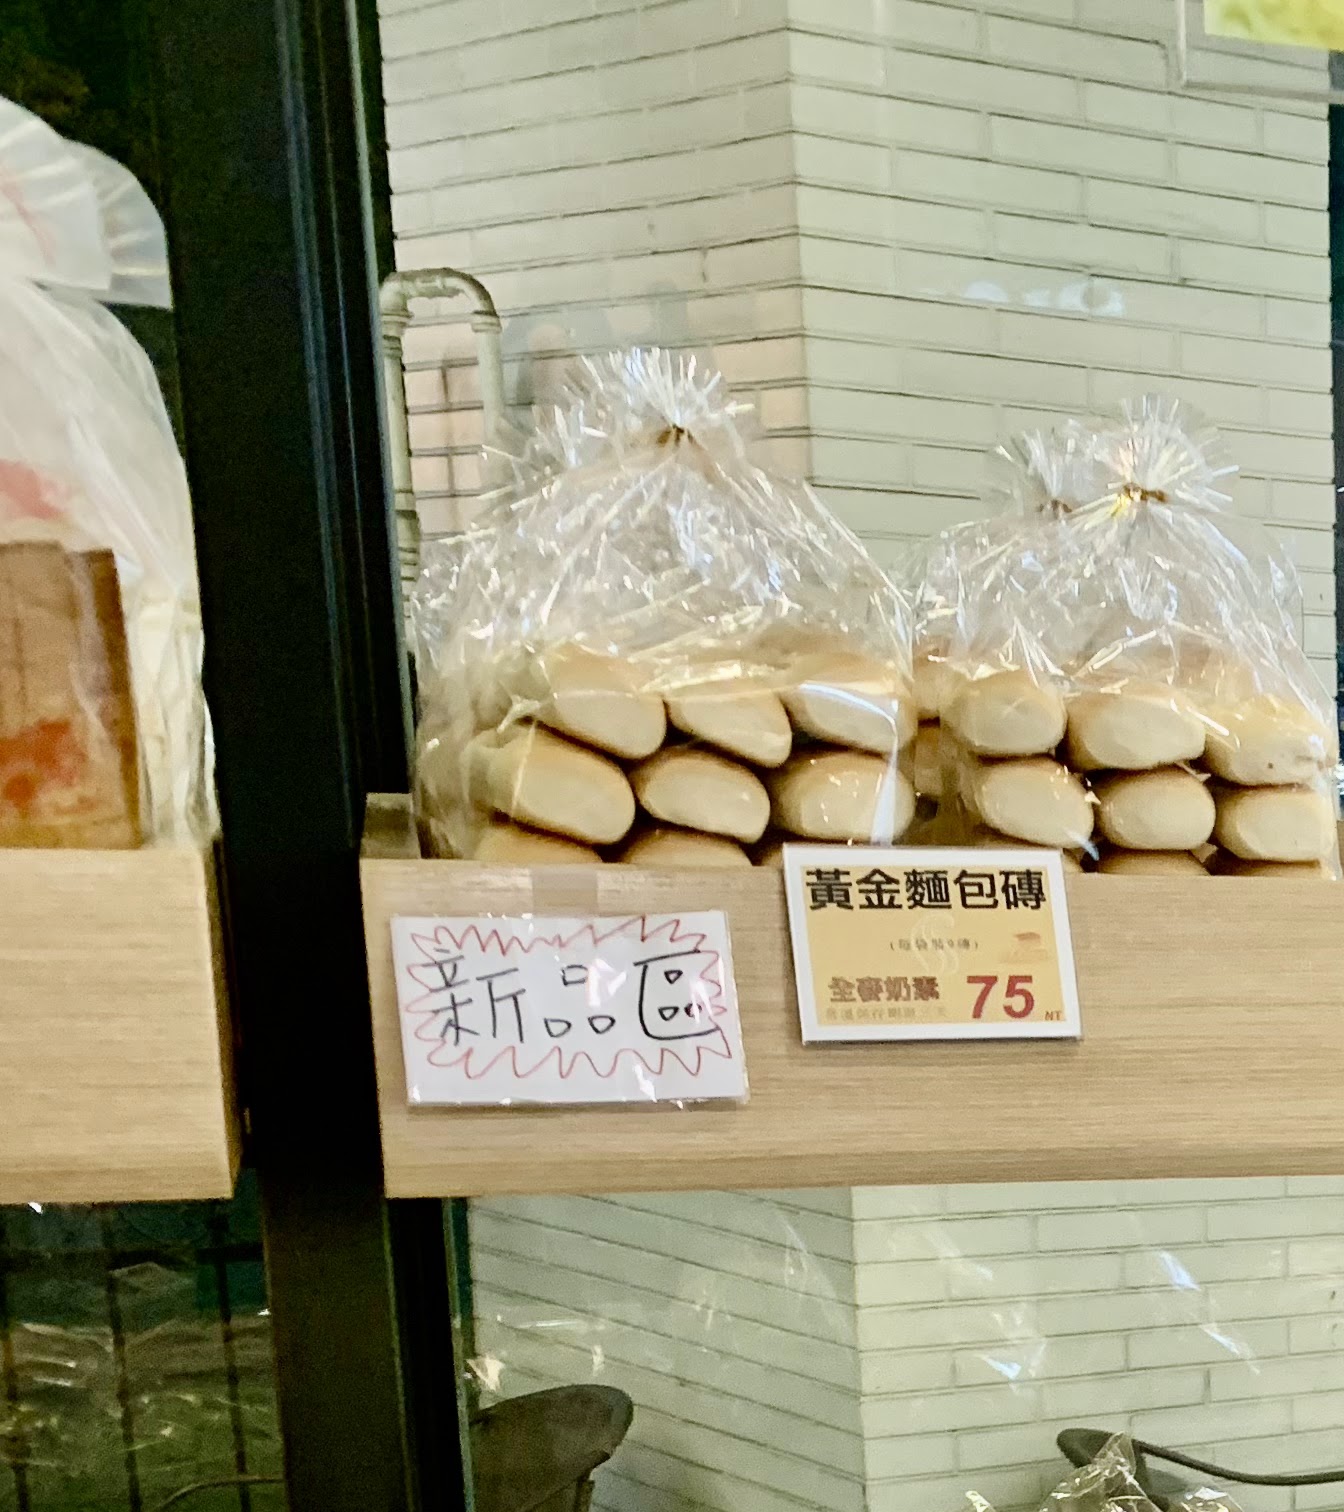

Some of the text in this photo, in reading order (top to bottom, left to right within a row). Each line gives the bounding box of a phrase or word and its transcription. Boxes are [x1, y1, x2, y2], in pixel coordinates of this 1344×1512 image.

[806, 868, 1046, 910] 黃金麵包磚
[421, 947, 721, 1047] 新品區
[966, 975, 1035, 1019] 75
